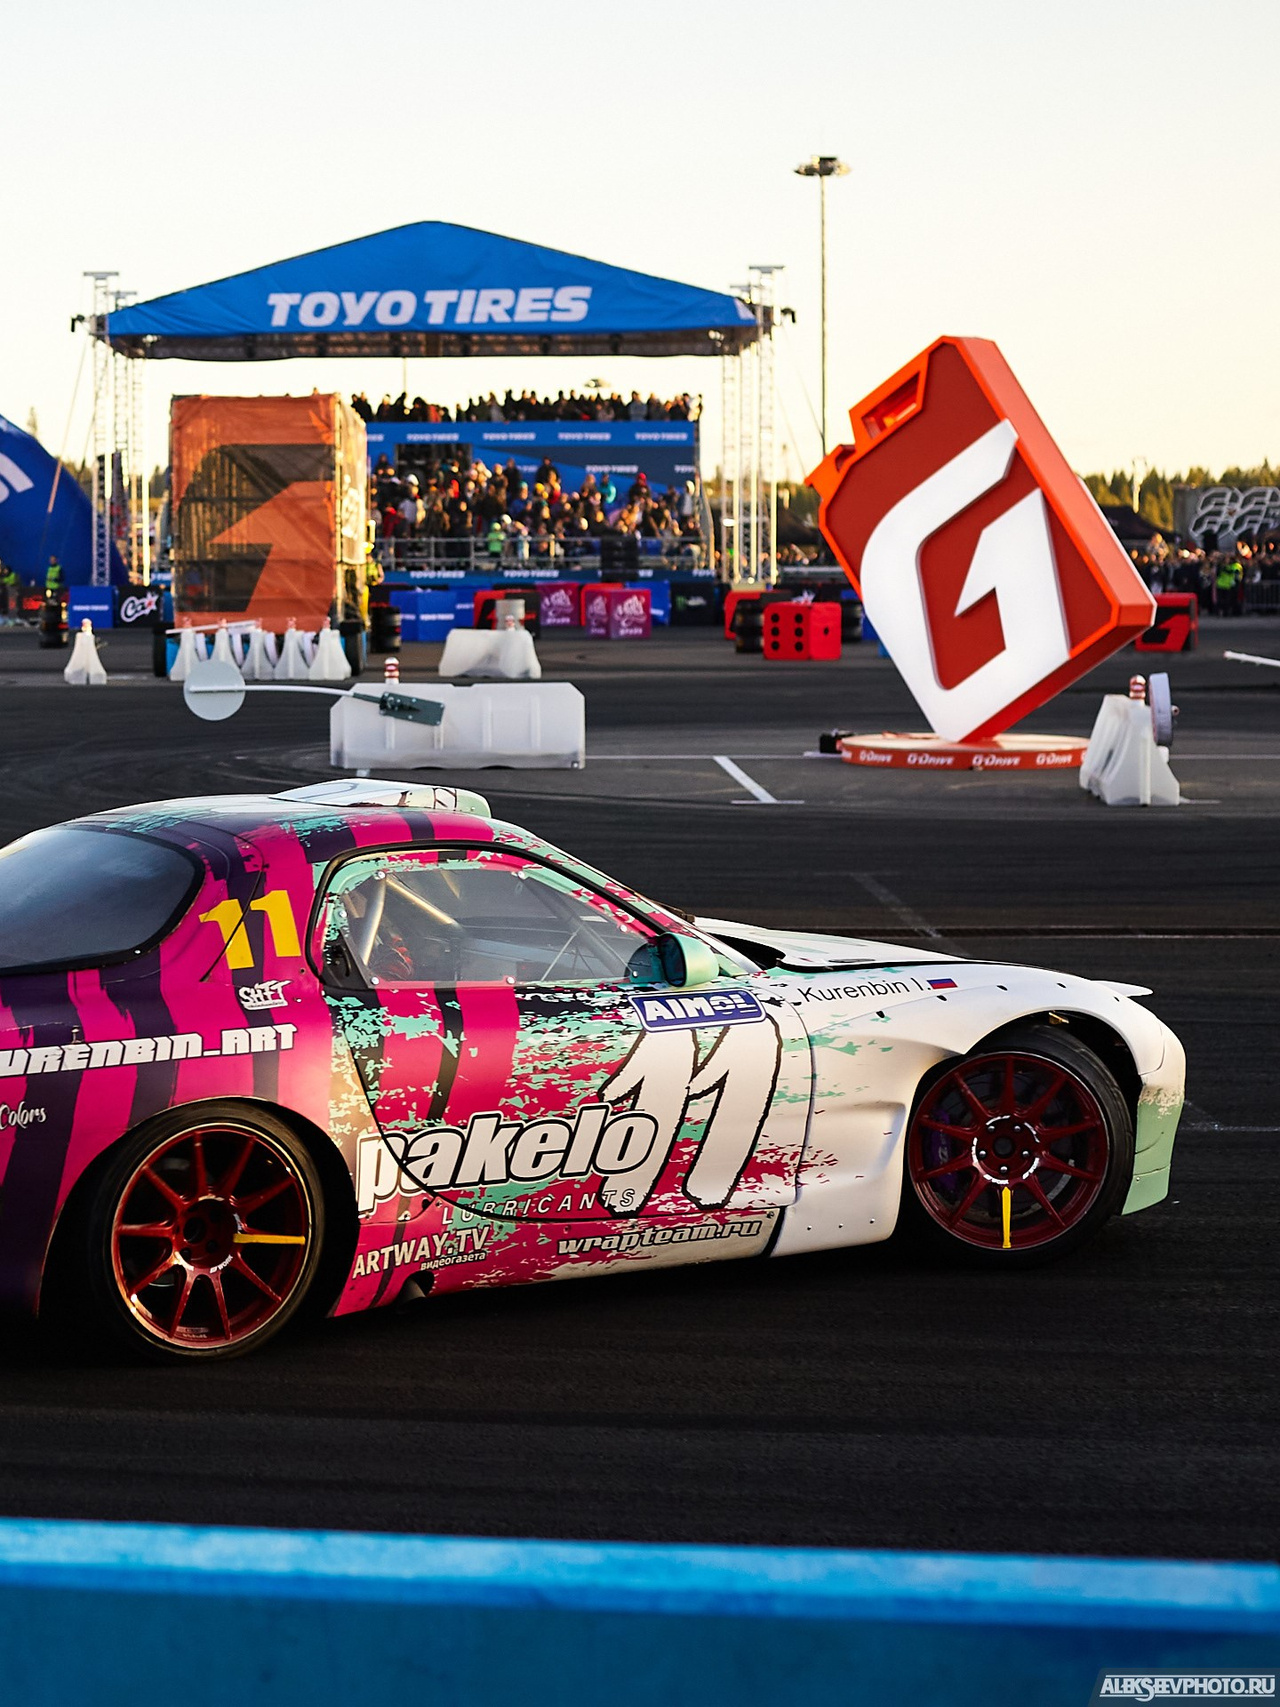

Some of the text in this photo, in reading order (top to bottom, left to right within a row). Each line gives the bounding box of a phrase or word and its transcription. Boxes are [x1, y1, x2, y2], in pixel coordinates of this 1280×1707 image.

[267, 286, 593, 327] TOYO TIRES
[859, 417, 1072, 743] G
[199, 890, 301, 969] 11
[642, 991, 756, 1022] AIMOL
[797, 980, 910, 1002] Kurenbin
[598, 1015, 784, 1216] 11
[357, 1103, 660, 1214] pakelo
[441, 1188, 636, 1225] LUBRICANTS
[352, 1225, 490, 1279] ARTWAY.TV
[558, 1217, 763, 1257] wrapteam.ru
[420, 1252, 487, 1271] видеогазета
